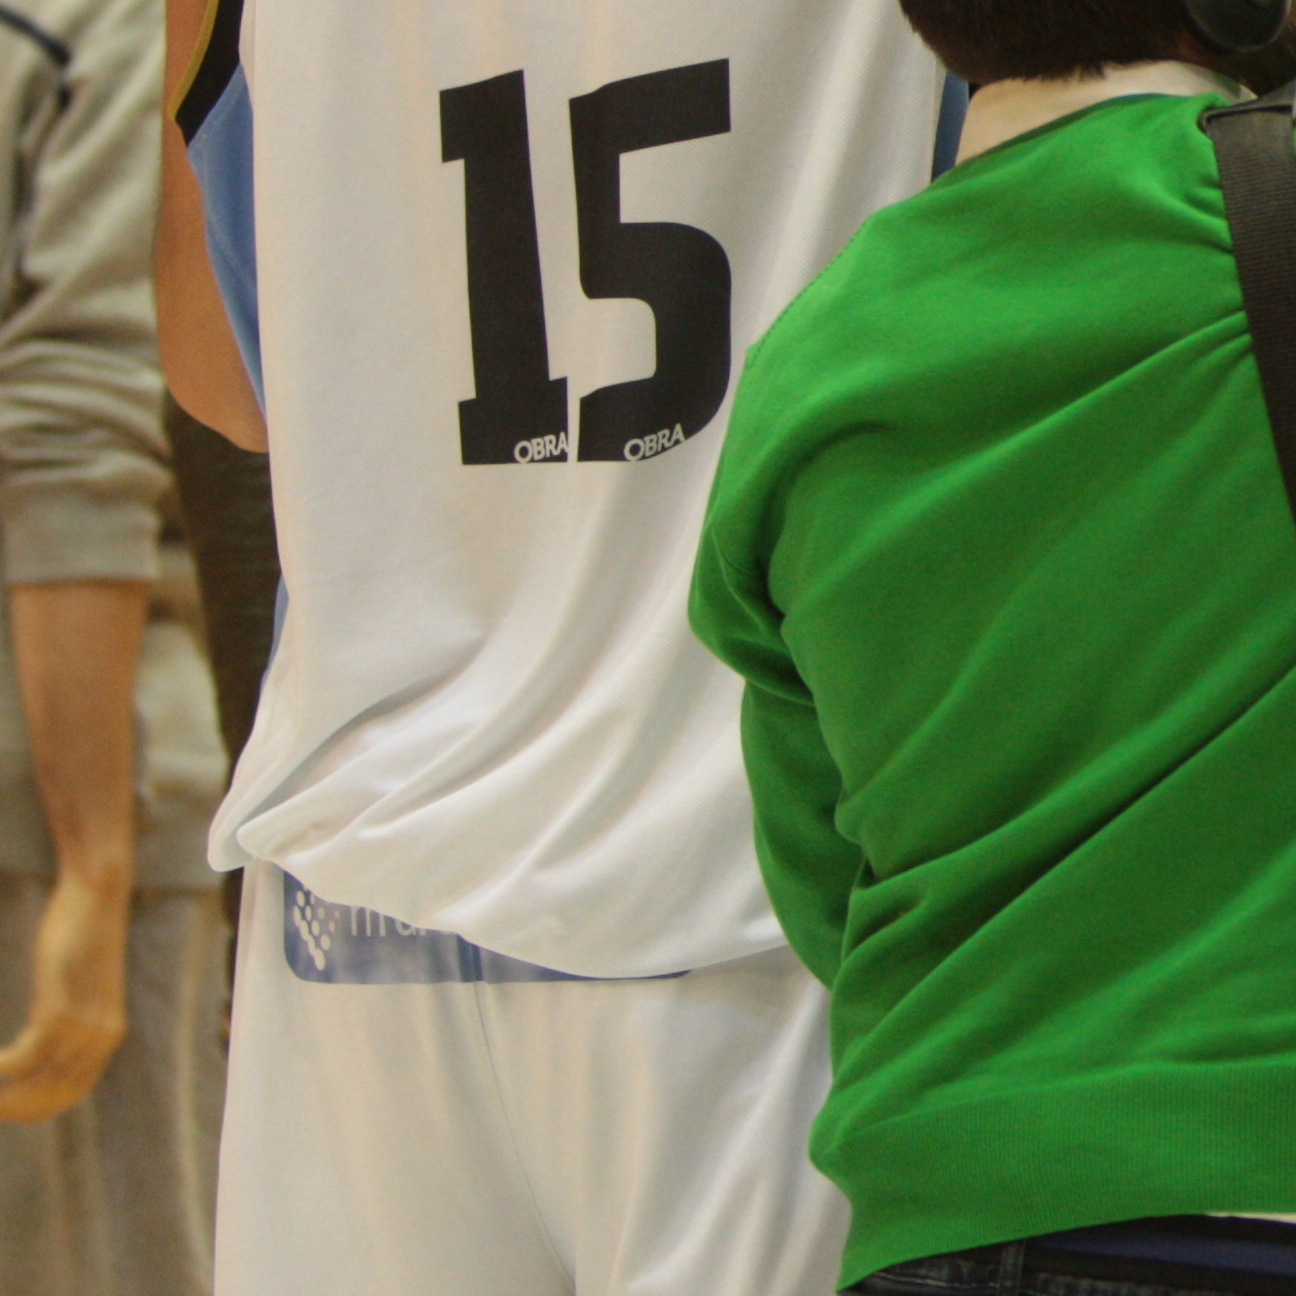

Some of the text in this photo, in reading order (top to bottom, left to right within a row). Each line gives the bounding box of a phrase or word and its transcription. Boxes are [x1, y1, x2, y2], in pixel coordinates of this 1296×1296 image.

[439, 58, 732, 465] 15
[514, 431, 569, 464] OBRA
[624, 423, 686, 461] OBRA
